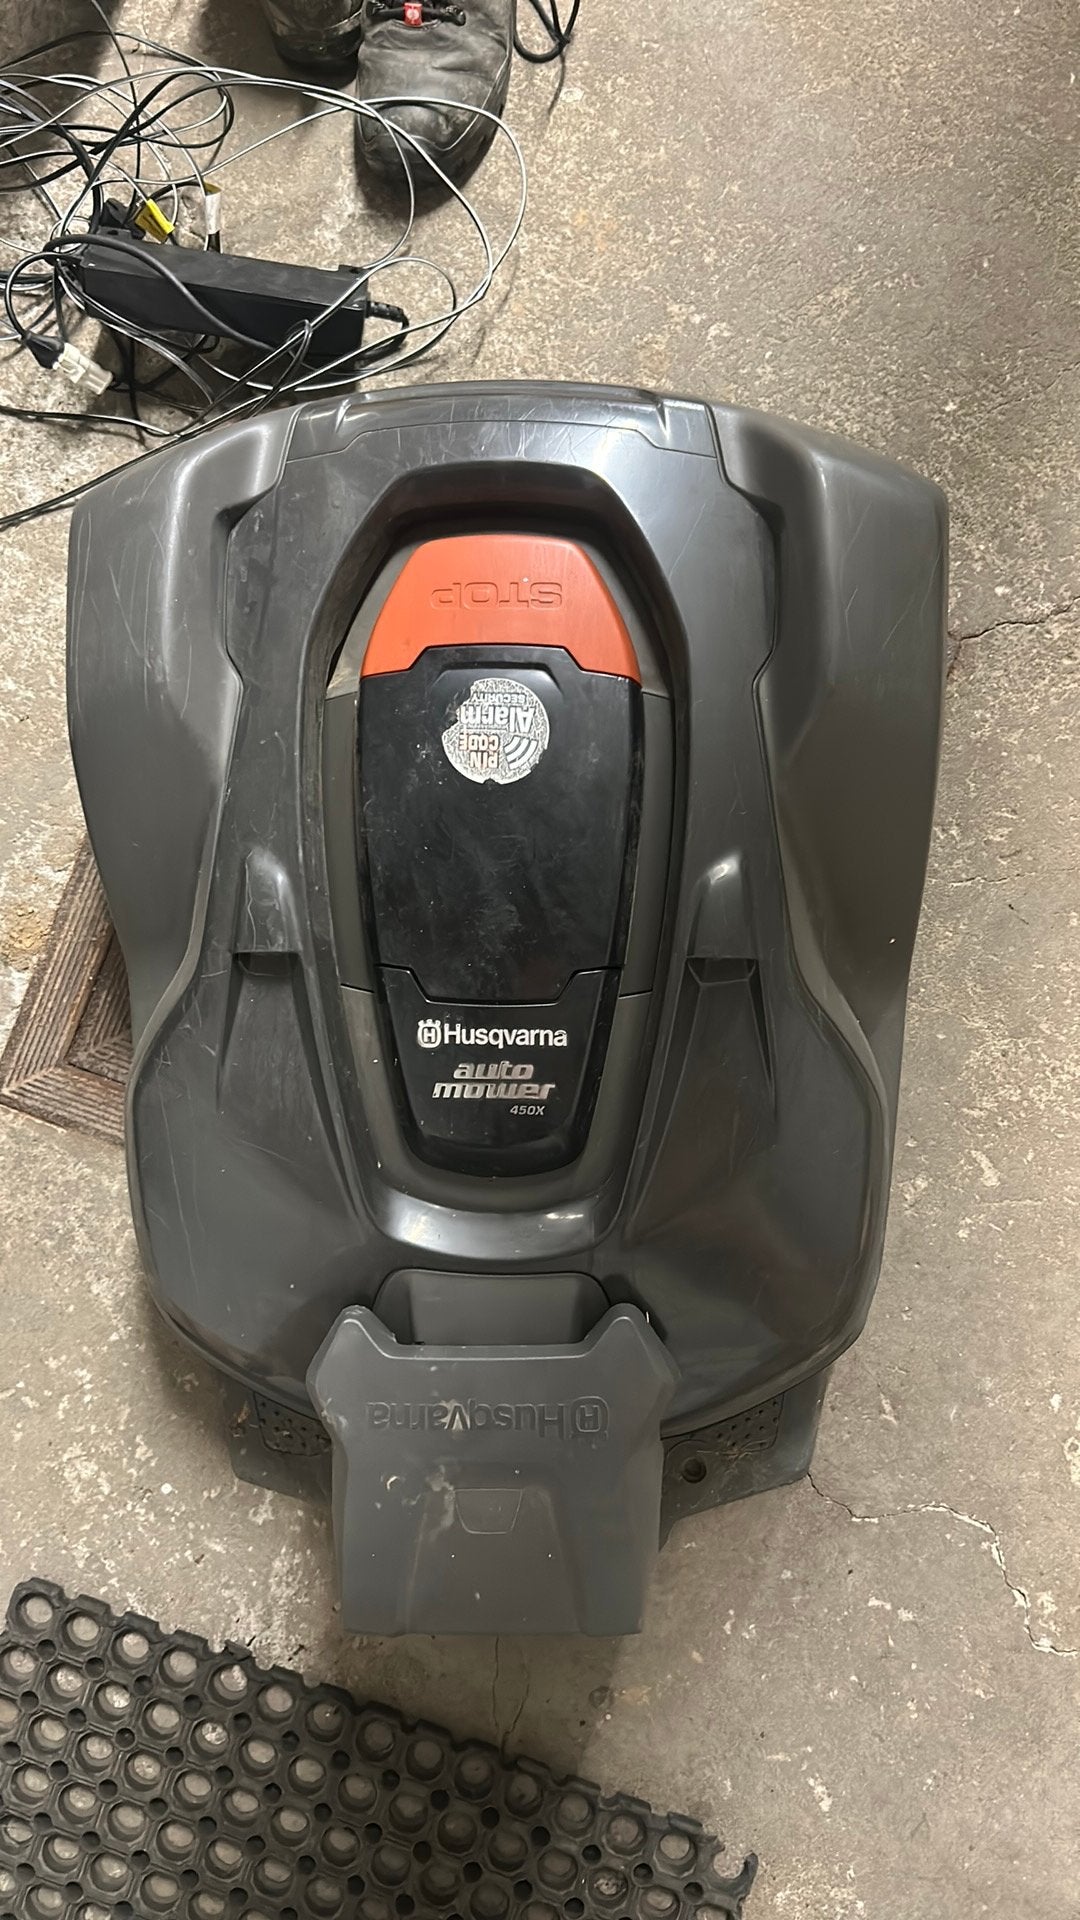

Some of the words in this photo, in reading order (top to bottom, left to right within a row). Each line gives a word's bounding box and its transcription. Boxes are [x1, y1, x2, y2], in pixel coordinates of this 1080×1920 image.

[431, 581, 563, 610] STOP
[470, 691, 527, 706] SECURITY
[459, 704, 535, 734] Alarm
[458, 733, 499, 751] CODE
[469, 751, 499, 768] PIN
[443, 1023, 568, 1049] Husqvarna
[453, 1060, 534, 1080] auto
[431, 1082, 556, 1100] mower
[509, 1104, 546, 1116] 450X
[366, 1398, 565, 1438] Husqvarna
